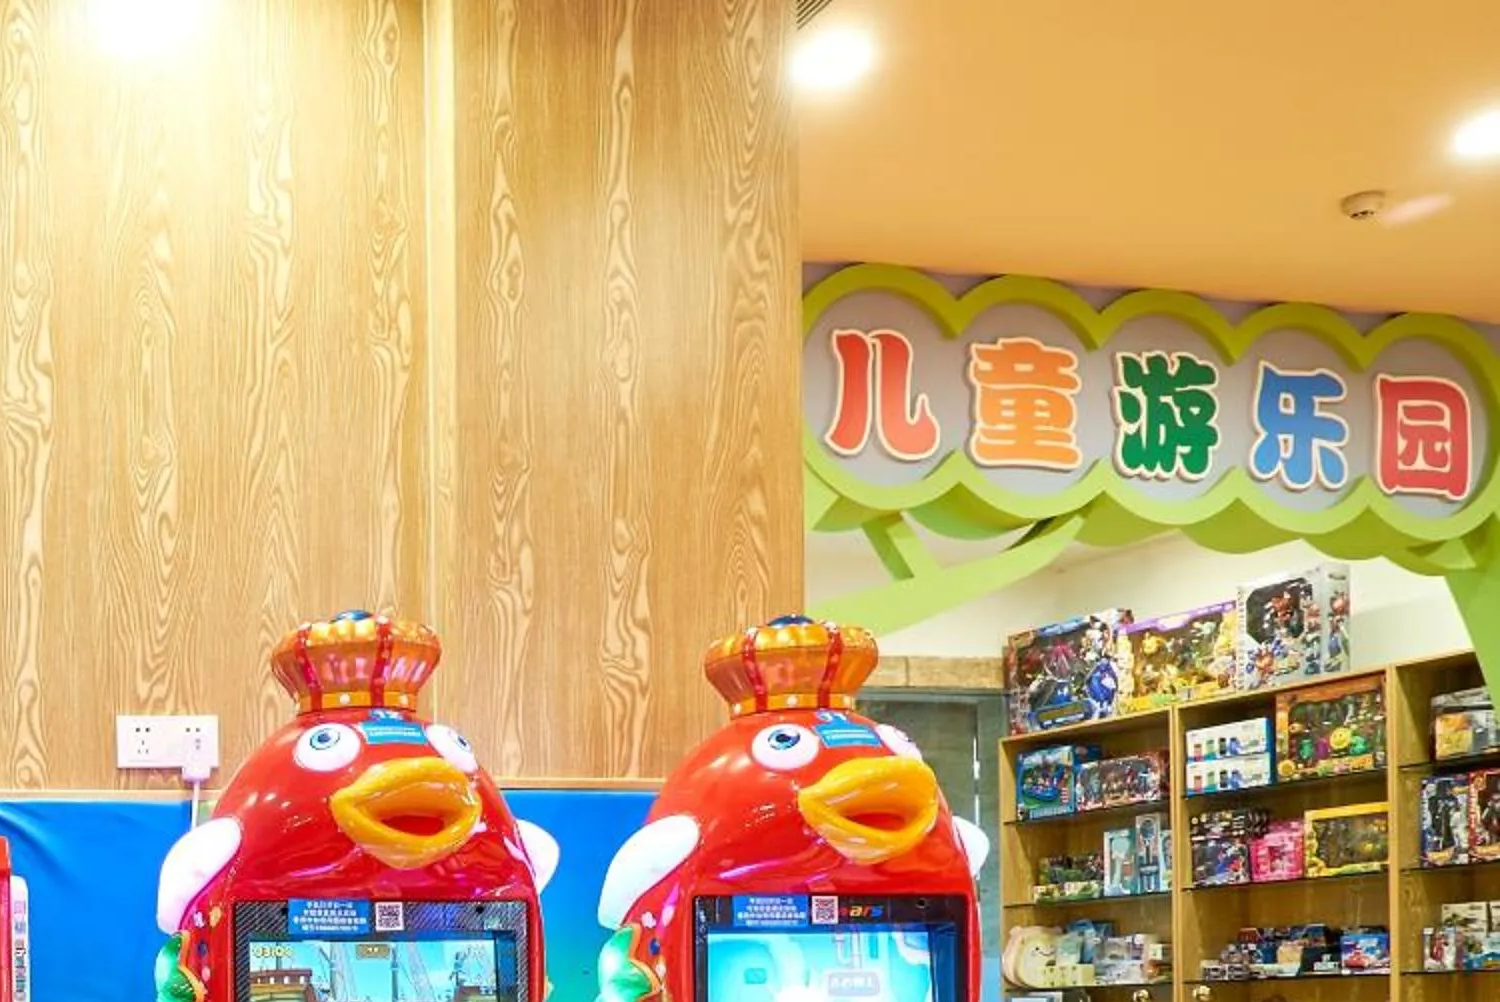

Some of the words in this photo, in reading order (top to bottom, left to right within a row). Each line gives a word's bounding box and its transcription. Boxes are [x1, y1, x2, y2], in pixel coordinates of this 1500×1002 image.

[824, 329, 1472, 500] 儿童游乐园
